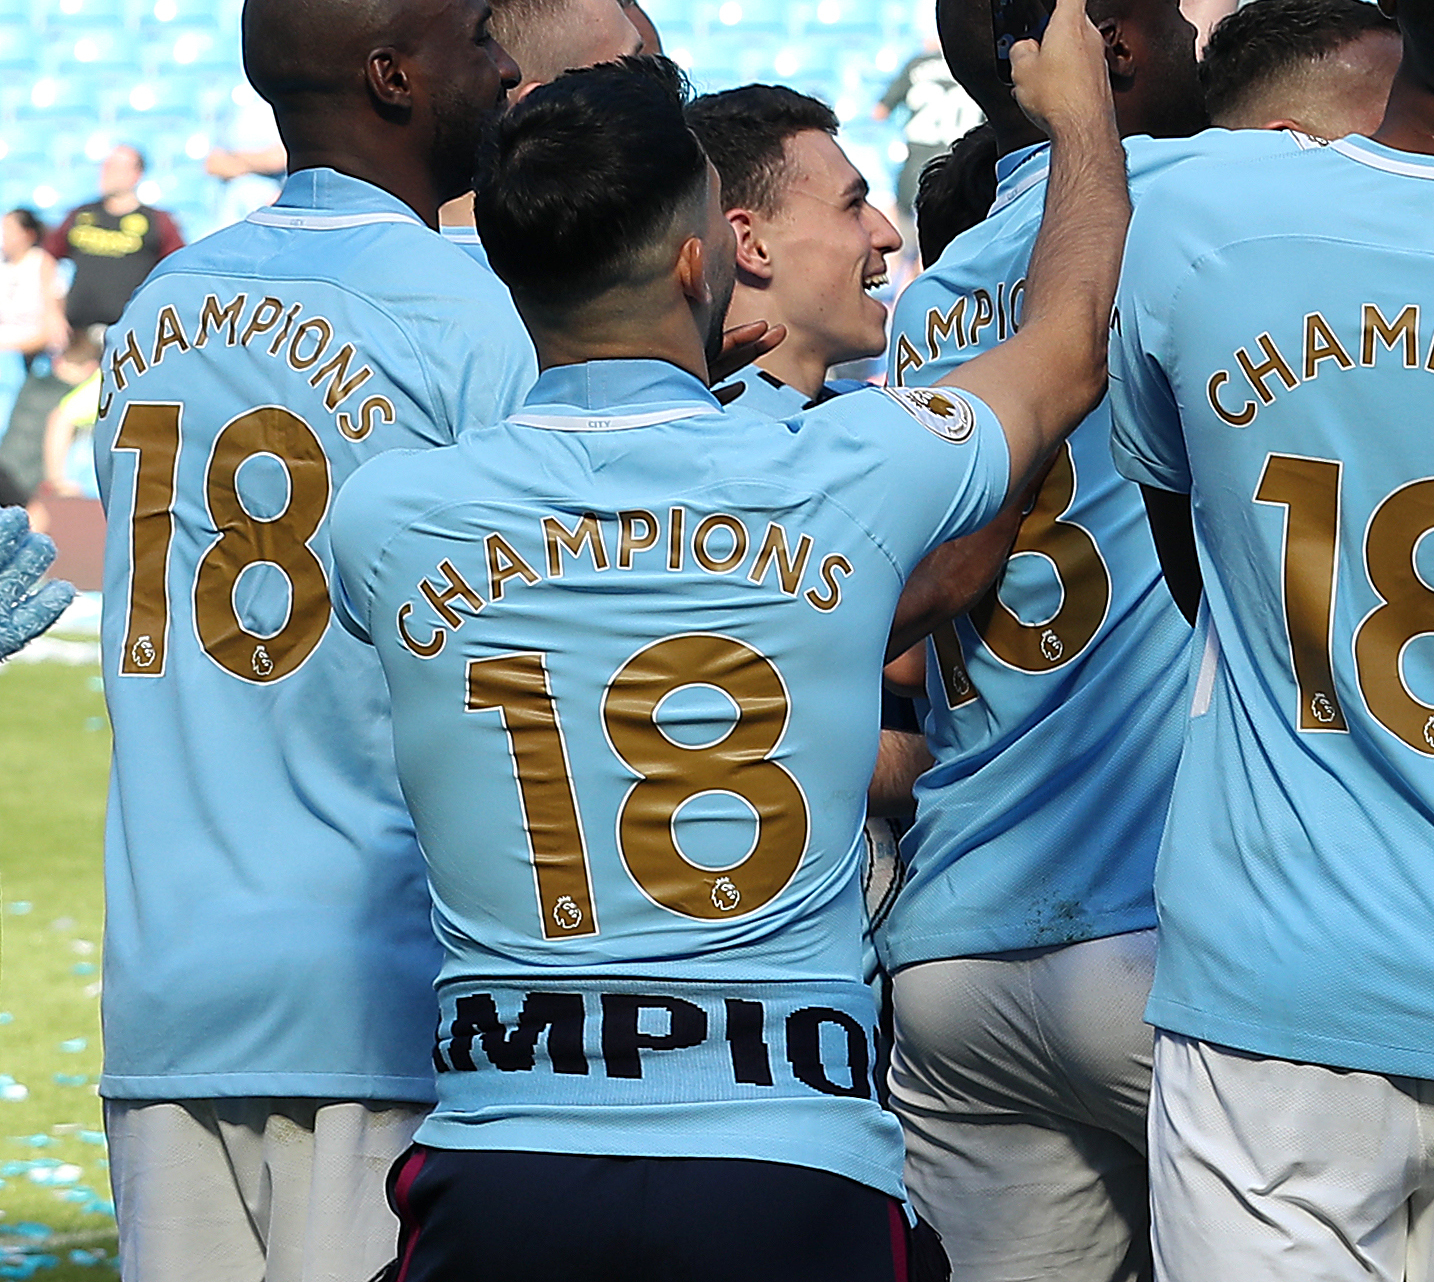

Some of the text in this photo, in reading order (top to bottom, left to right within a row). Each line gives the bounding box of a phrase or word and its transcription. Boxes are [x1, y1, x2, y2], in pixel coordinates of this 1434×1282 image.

[587, 420, 612, 429] CITY
[111, 401, 333, 685] 18
[396, 507, 858, 662] CHAMPIONS
[463, 632, 811, 940] 18
